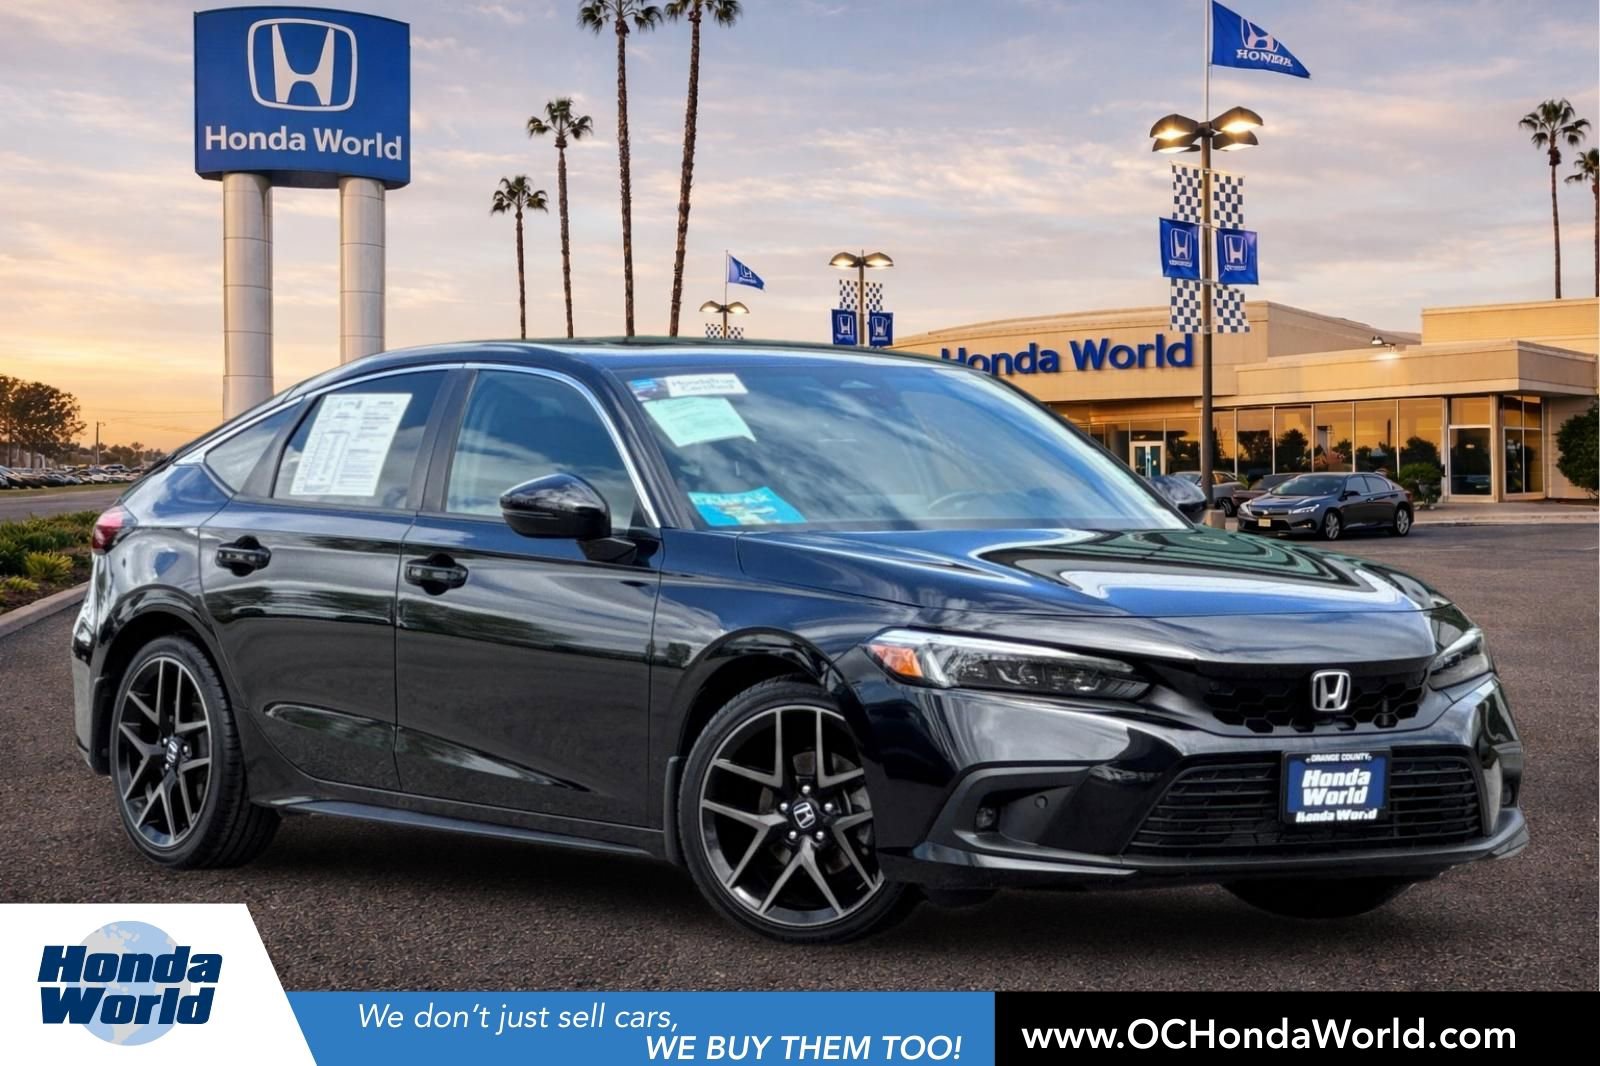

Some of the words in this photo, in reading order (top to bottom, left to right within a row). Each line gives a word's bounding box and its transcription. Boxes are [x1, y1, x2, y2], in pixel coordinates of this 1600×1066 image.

[204, 125, 307, 151] Honda
[313, 127, 402, 161] World
[1069, 333, 1194, 371] World
[1311, 753, 1340, 763] ORANGE
[1341, 752, 1370, 761] COUNTY
[1302, 768, 1371, 788] Honda
[1303, 786, 1368, 806] World
[1296, 810, 1335, 823] Honda
